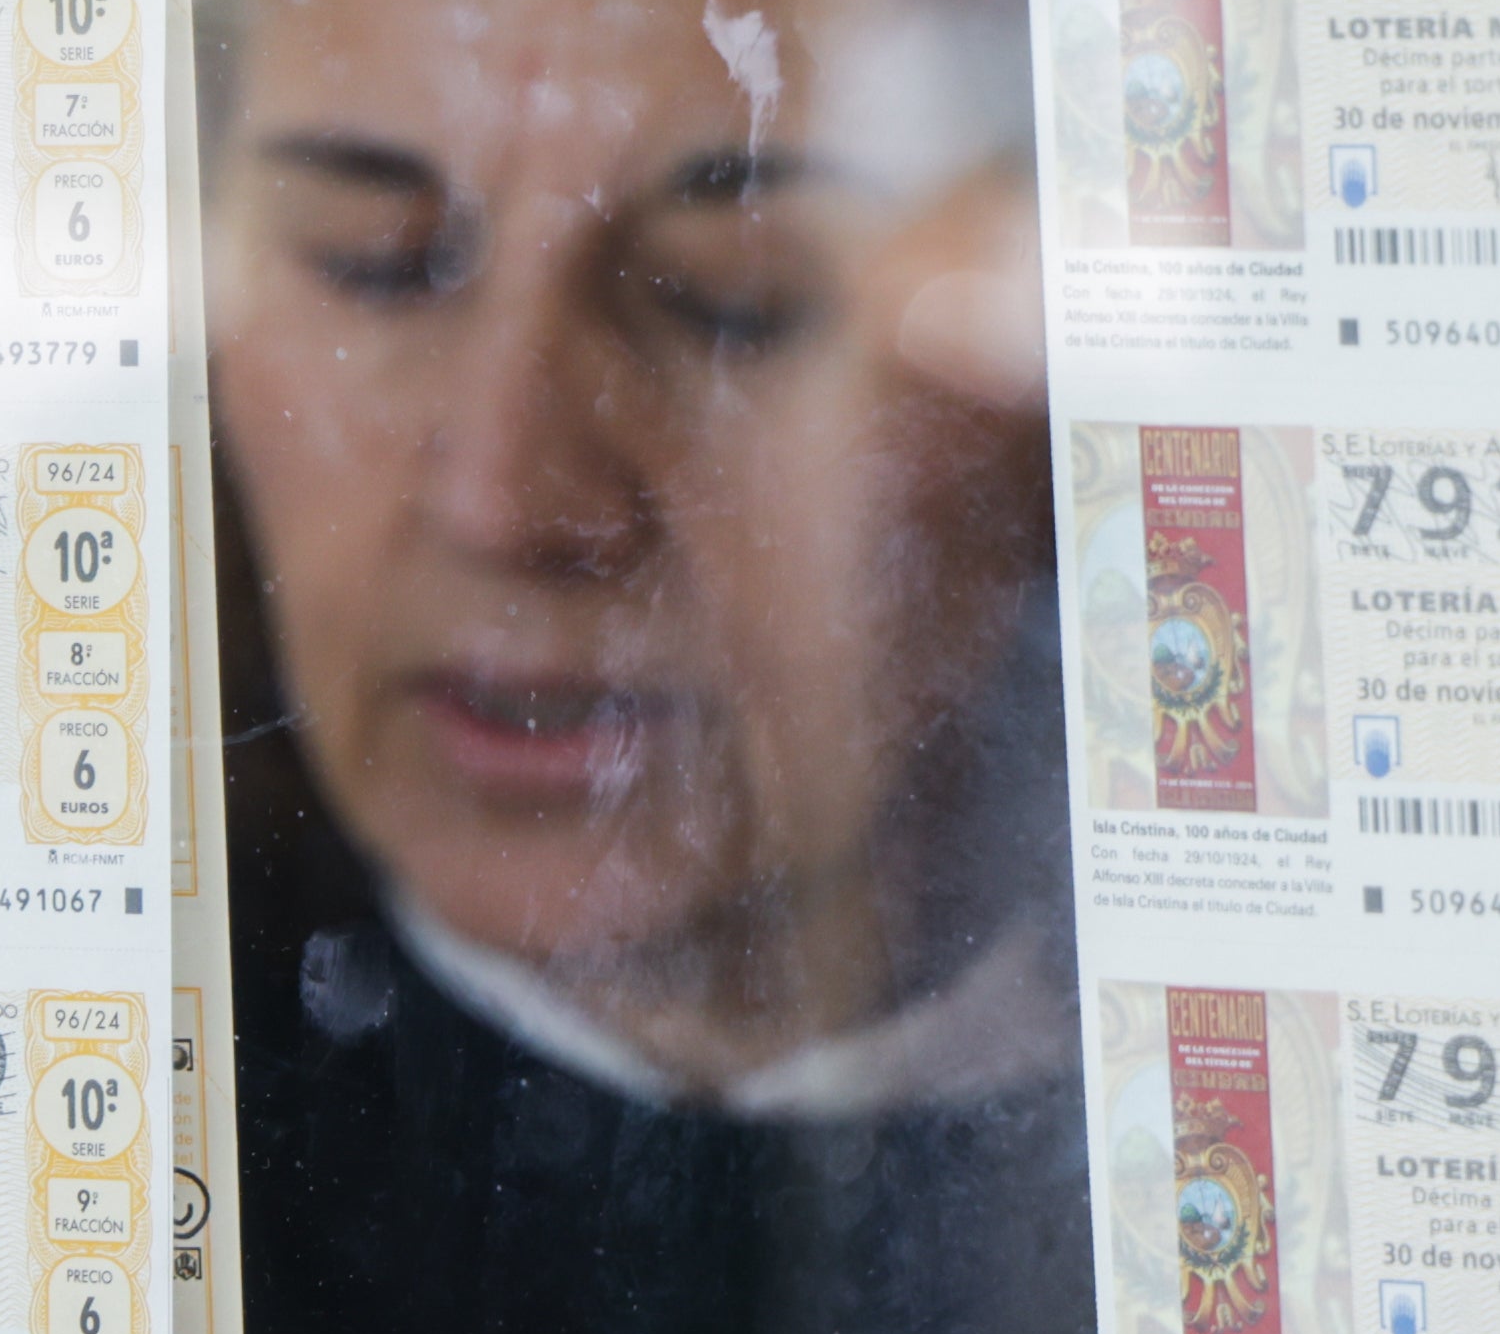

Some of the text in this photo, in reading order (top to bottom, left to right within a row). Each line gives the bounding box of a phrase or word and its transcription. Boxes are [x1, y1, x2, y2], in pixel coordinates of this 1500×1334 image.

[1328, 16, 1474, 40] LOTERÍA
[1351, 589, 1498, 613] LOTERÍA
[54, 1010, 121, 1031] 96/24
[71, 1141, 106, 1158] SERIE
[54, 1215, 124, 1235] FRACCIÓN
[1383, 1242, 1412, 1266] 30
[1421, 1244, 1453, 1268] de
[66, 1269, 113, 1285] PRECIO
